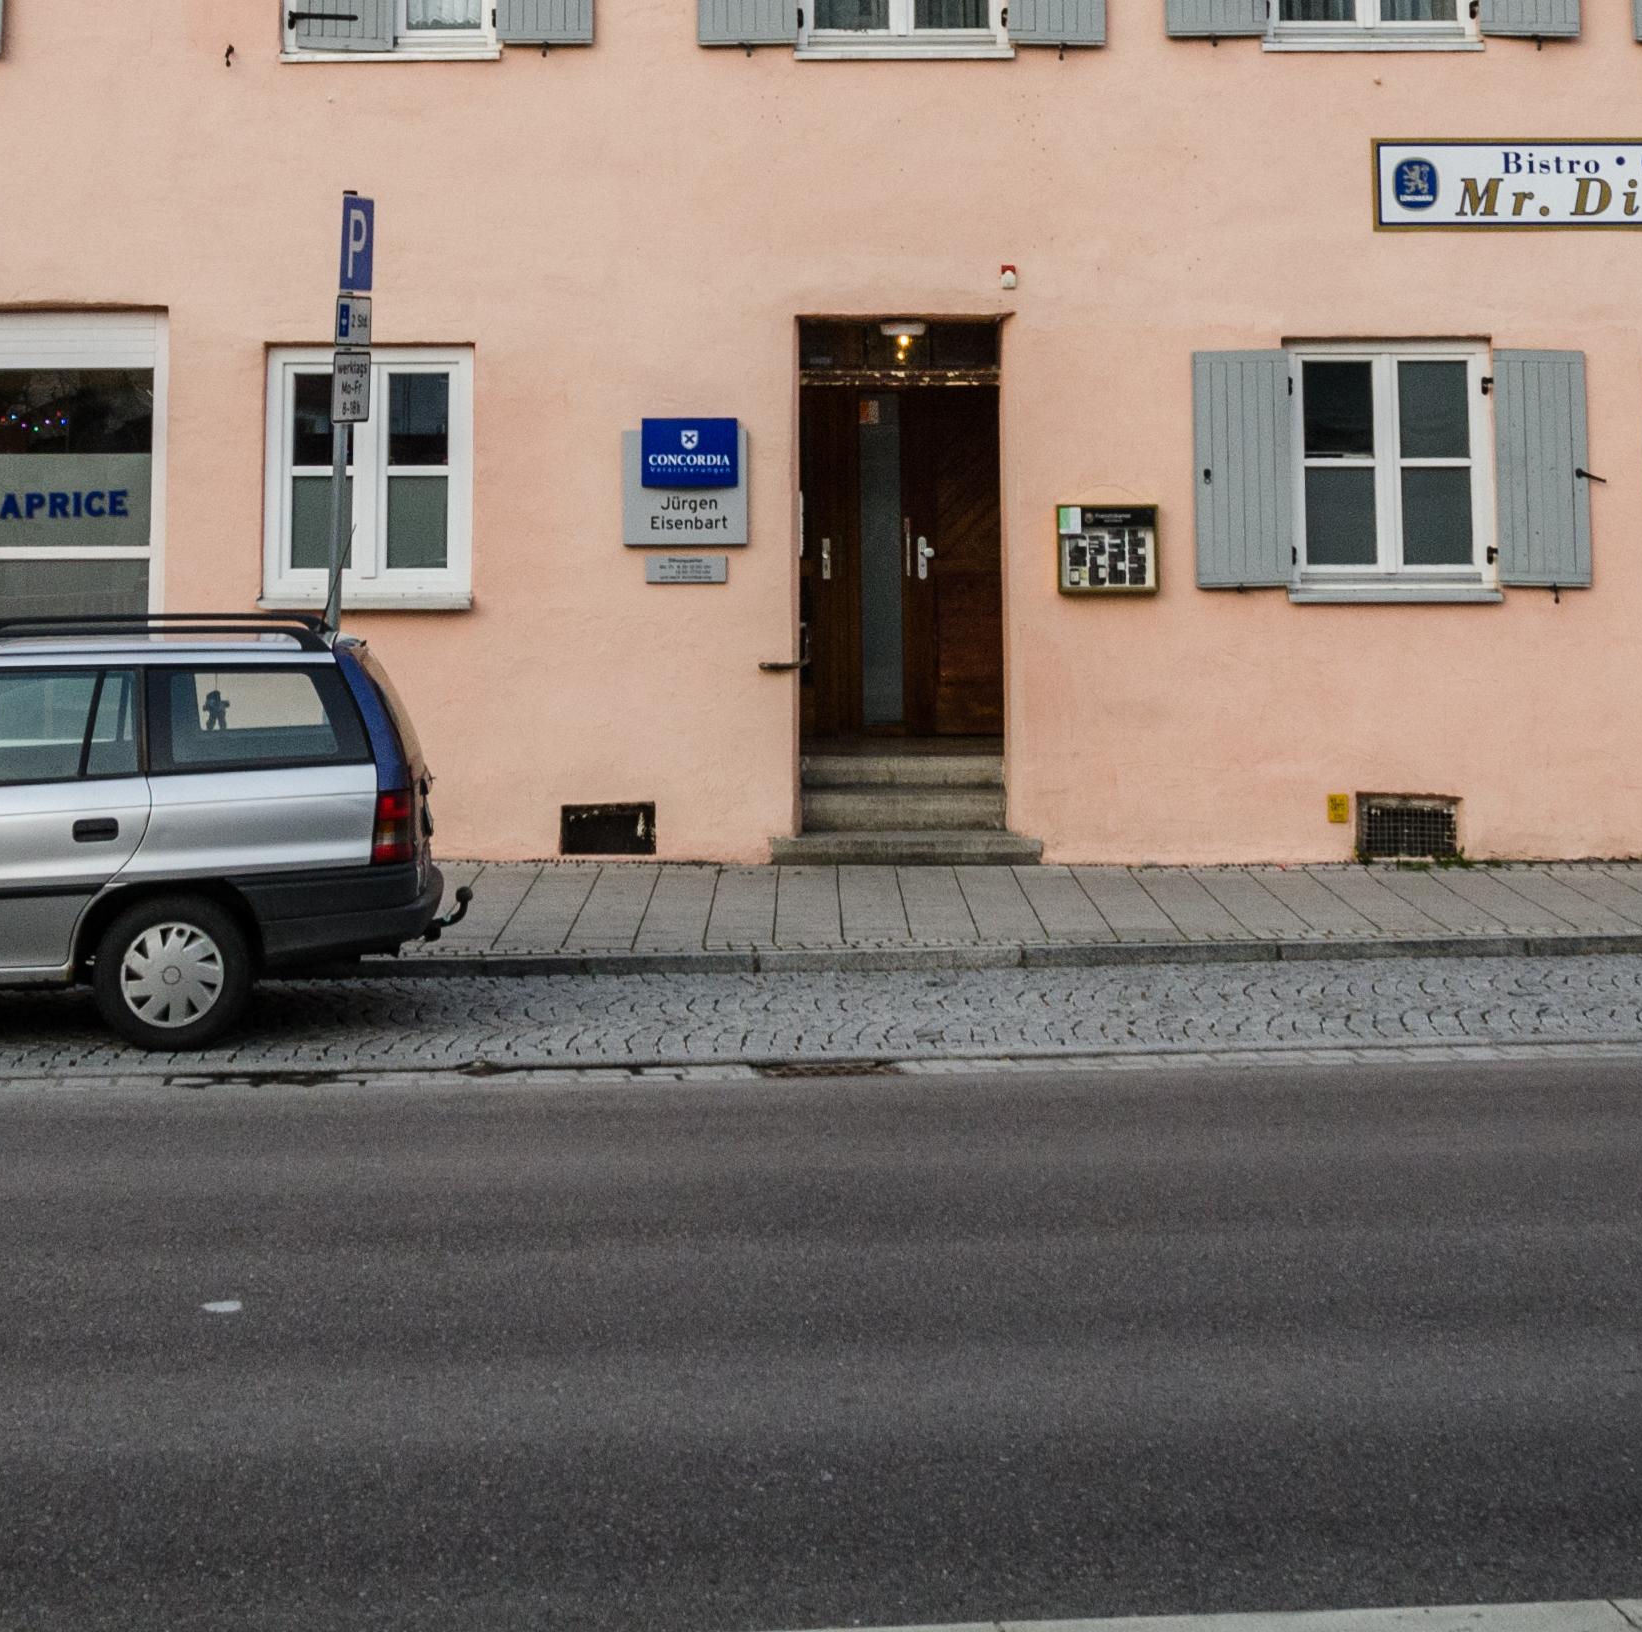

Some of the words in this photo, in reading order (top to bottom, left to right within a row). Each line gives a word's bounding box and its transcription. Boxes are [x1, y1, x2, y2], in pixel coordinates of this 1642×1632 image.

[1502, 152, 1600, 174] Bistro
[1455, 178, 1550, 216] Mr.
[347, 209, 367, 279] P
[351, 314, 356, 328] 2
[338, 360, 368, 378] werktags
[341, 380, 362, 395] Mo-Fr
[648, 454, 730, 466] CONCORDIA
[661, 496, 718, 513] Jürgen
[650, 515, 728, 530] Eisenbart
